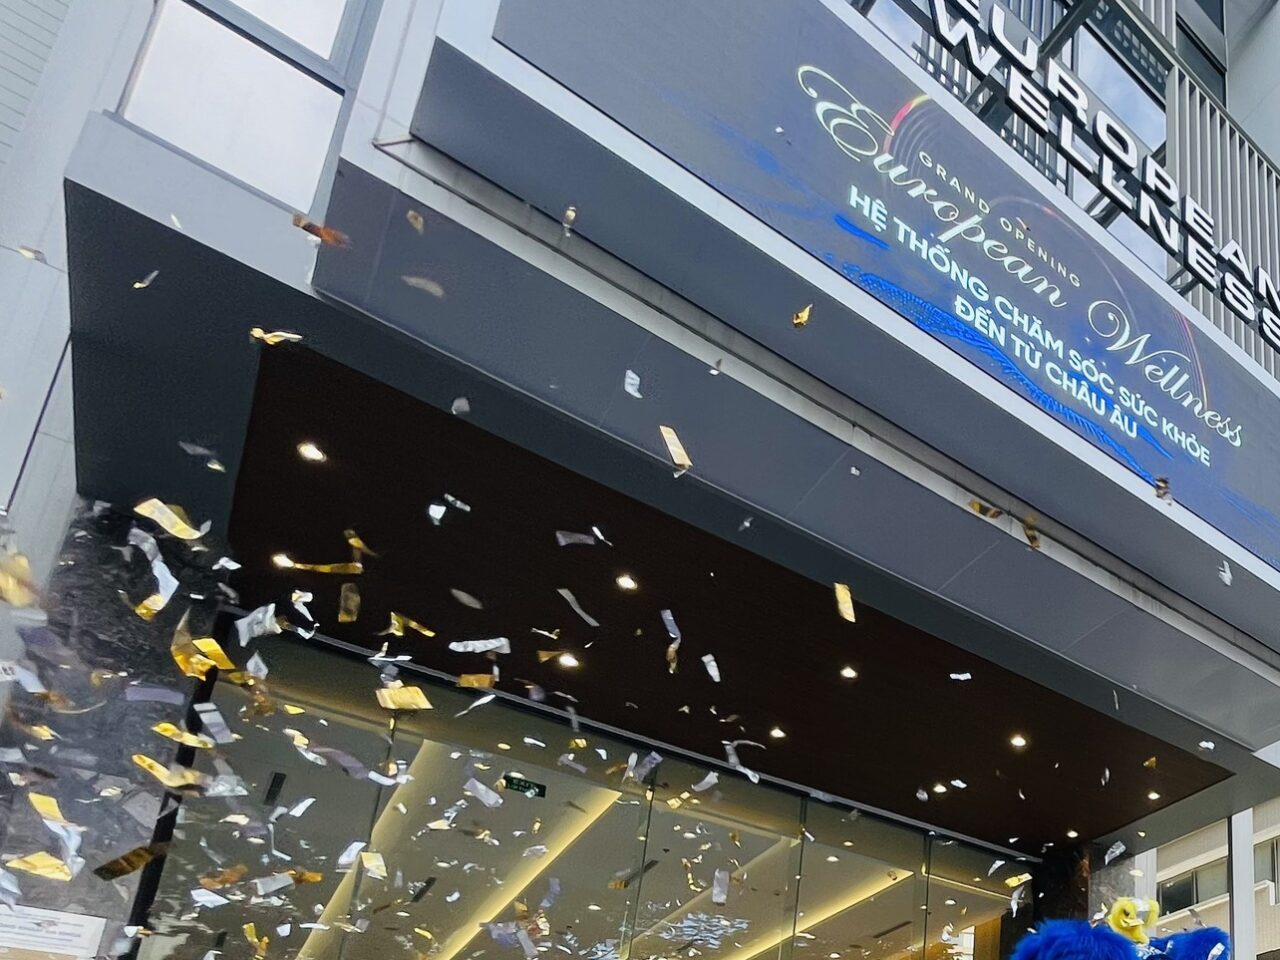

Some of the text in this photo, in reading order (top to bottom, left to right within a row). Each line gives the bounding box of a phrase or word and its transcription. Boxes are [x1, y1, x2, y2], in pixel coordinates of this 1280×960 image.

[797, 65, 1244, 447] European Wellness
[918, 151, 1081, 288] GRAND OPENING
[849, 185, 1211, 468] HỆ THỐNG CHĂM SÓC SỨC KHỎE
[954, 294, 1138, 438] ĐẾN TỪ CHÂU ÂU
